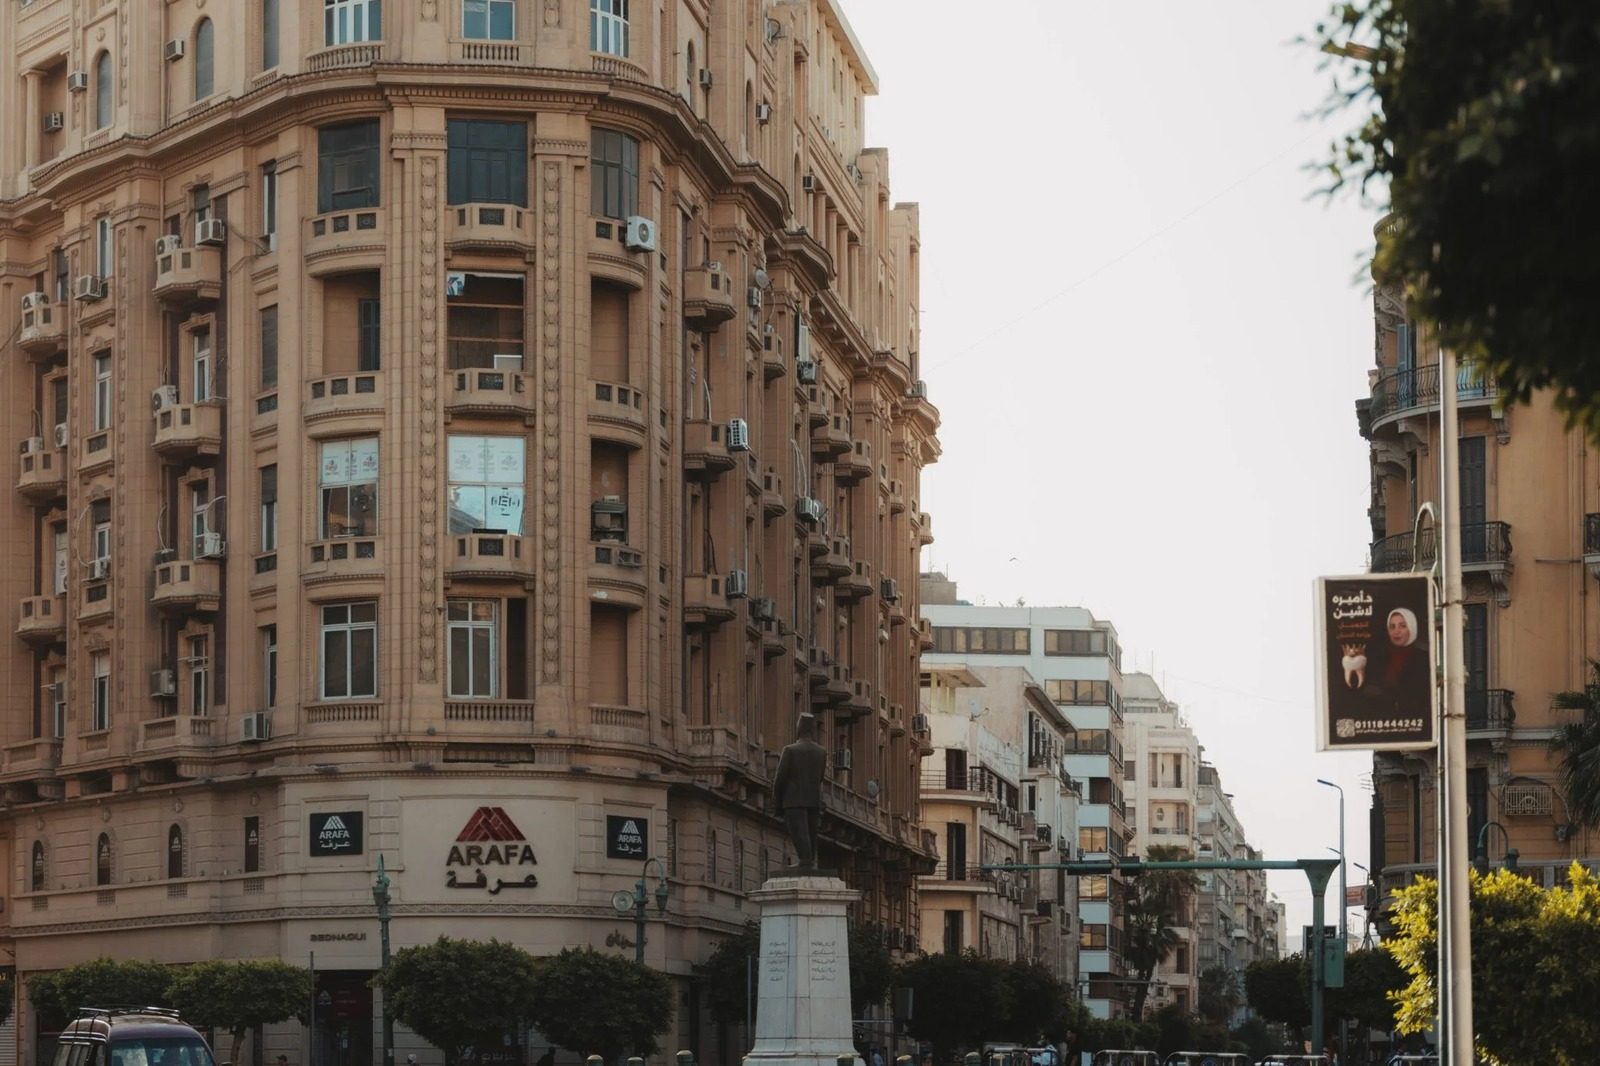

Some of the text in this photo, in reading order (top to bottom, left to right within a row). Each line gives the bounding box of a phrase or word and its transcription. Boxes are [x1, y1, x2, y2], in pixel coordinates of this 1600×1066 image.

[1355, 718, 1424, 729] 01118444242
[319, 830, 351, 840] ARAFA
[617, 834, 643, 844] ARAFA
[445, 844, 538, 866] ARAFA
[445, 868, 539, 896] عرفة
